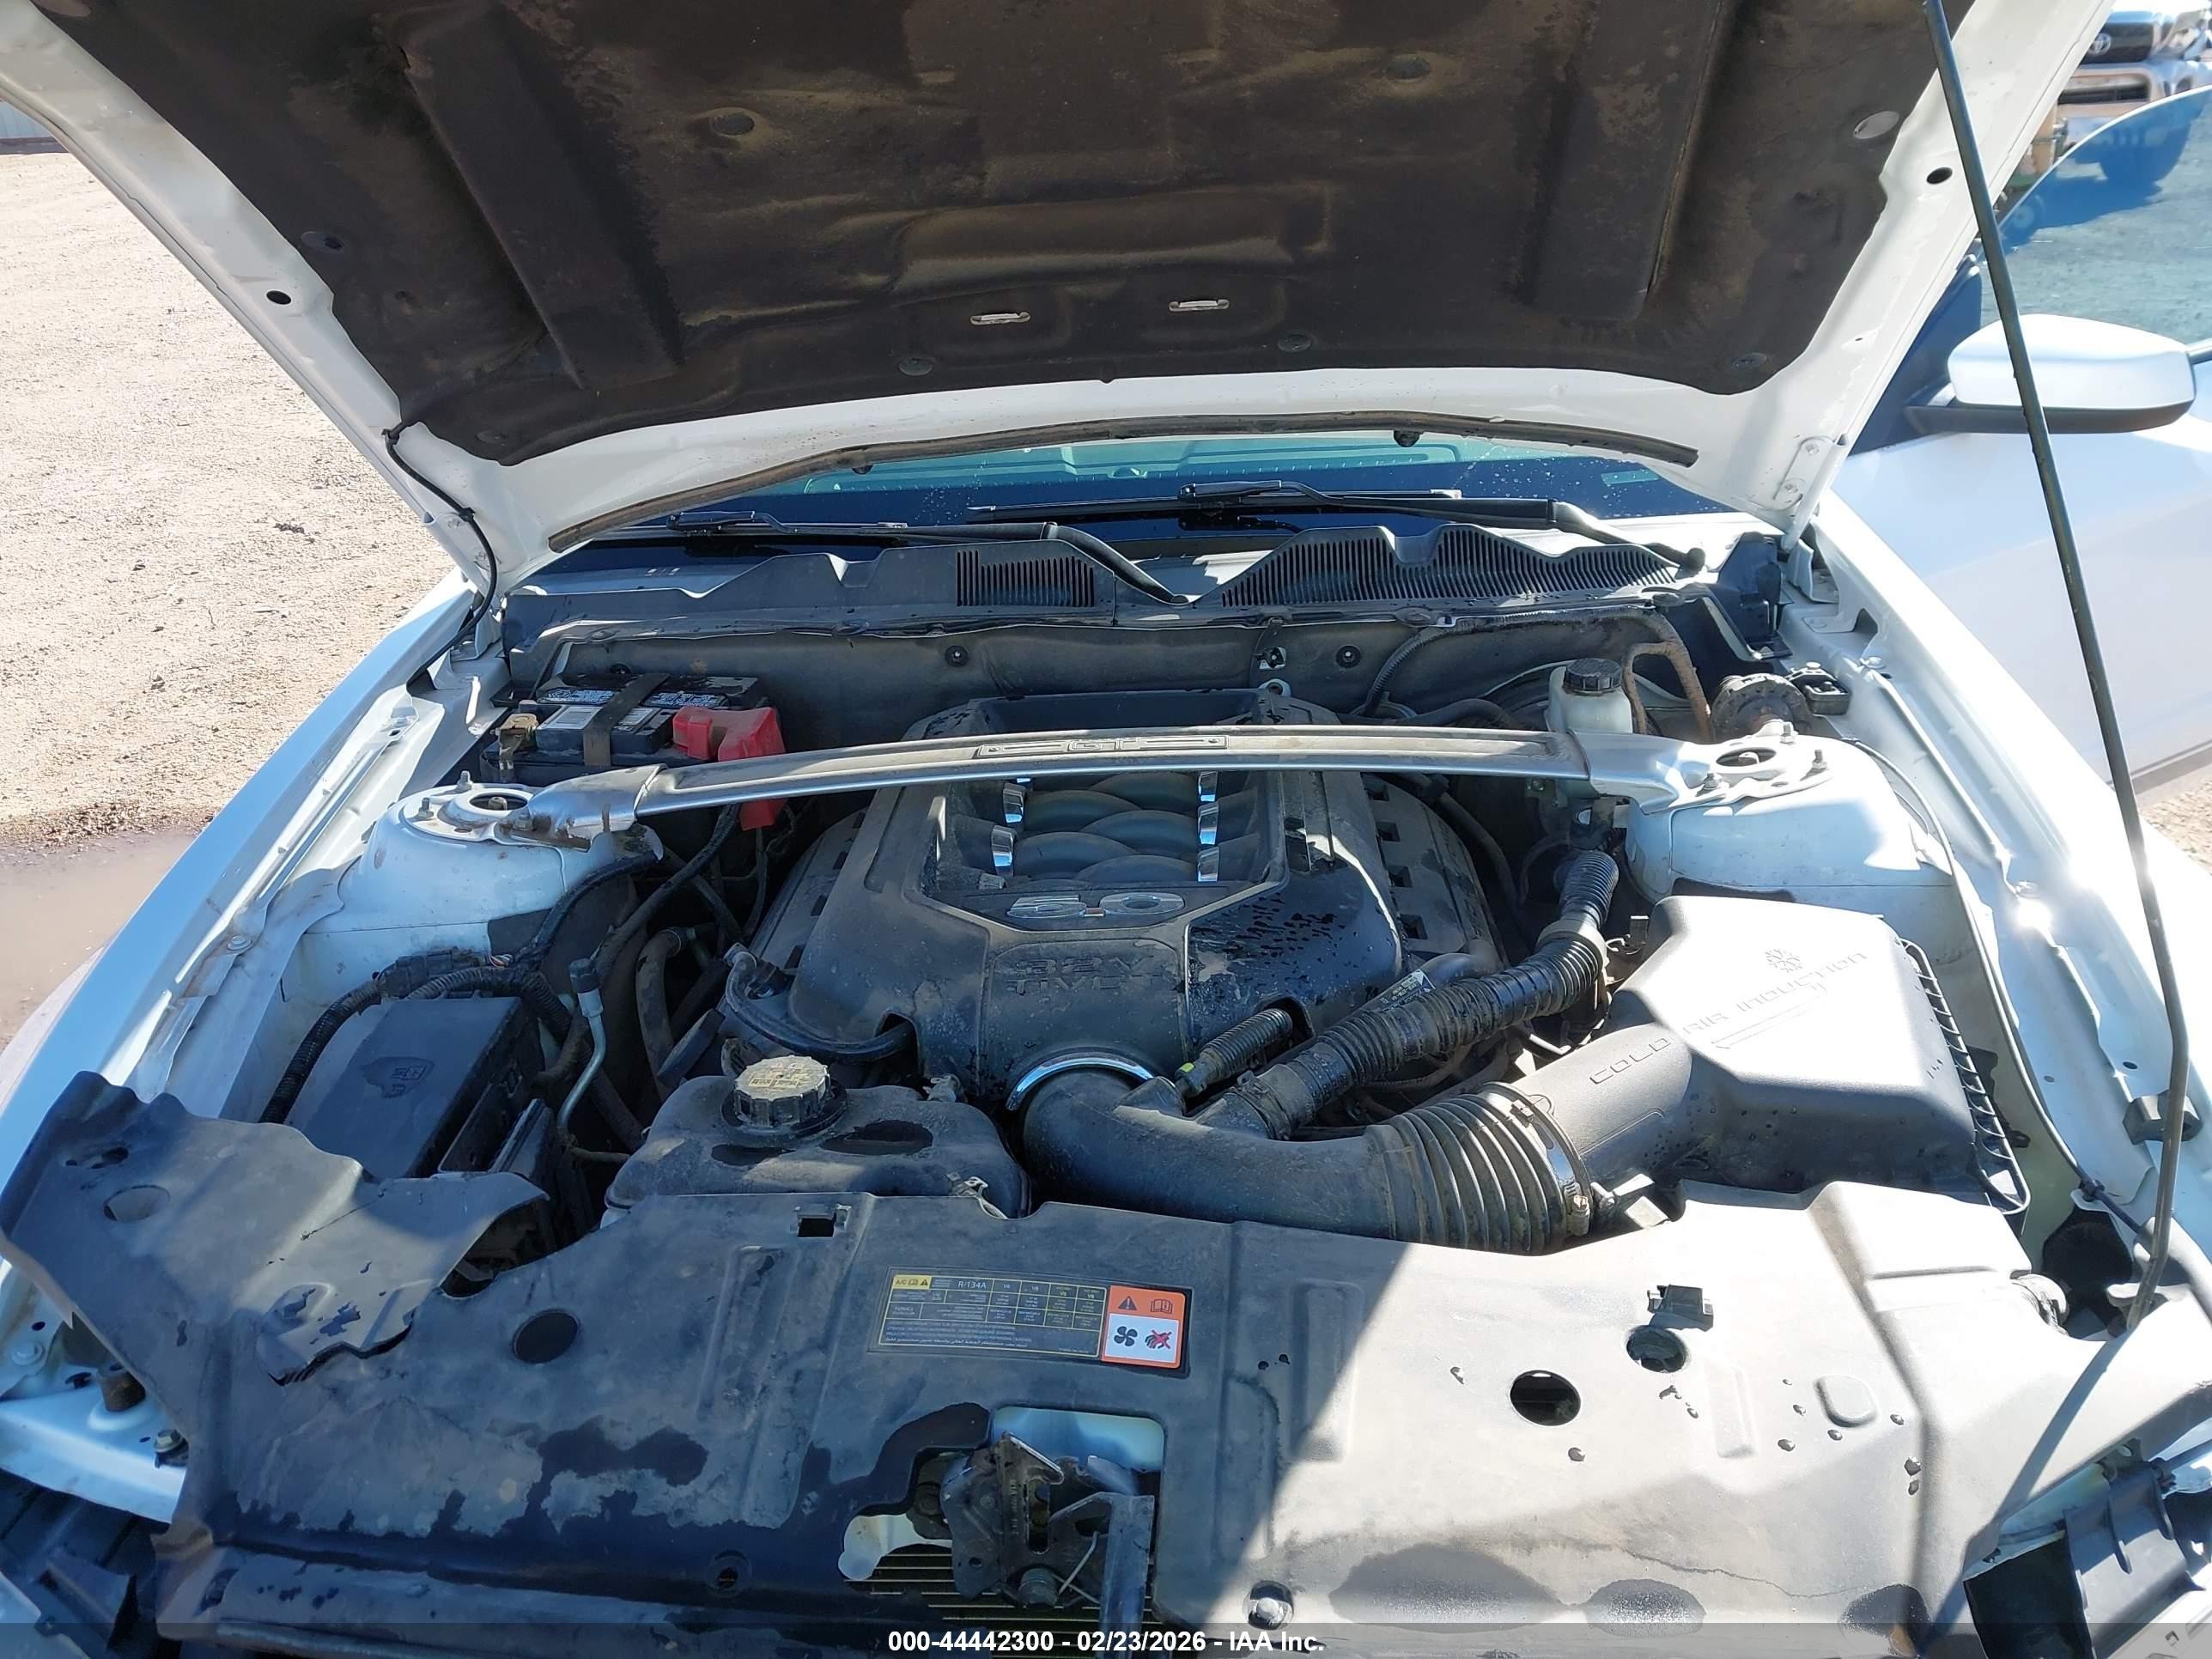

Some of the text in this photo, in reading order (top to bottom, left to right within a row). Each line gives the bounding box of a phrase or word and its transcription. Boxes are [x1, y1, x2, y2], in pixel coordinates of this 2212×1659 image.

[1006, 891, 1186, 919] 5.0
[1589, 1036, 1672, 1085] COLD
[1682, 1012, 1730, 1036] AIR
[957, 1279, 988, 1290] R-134A
